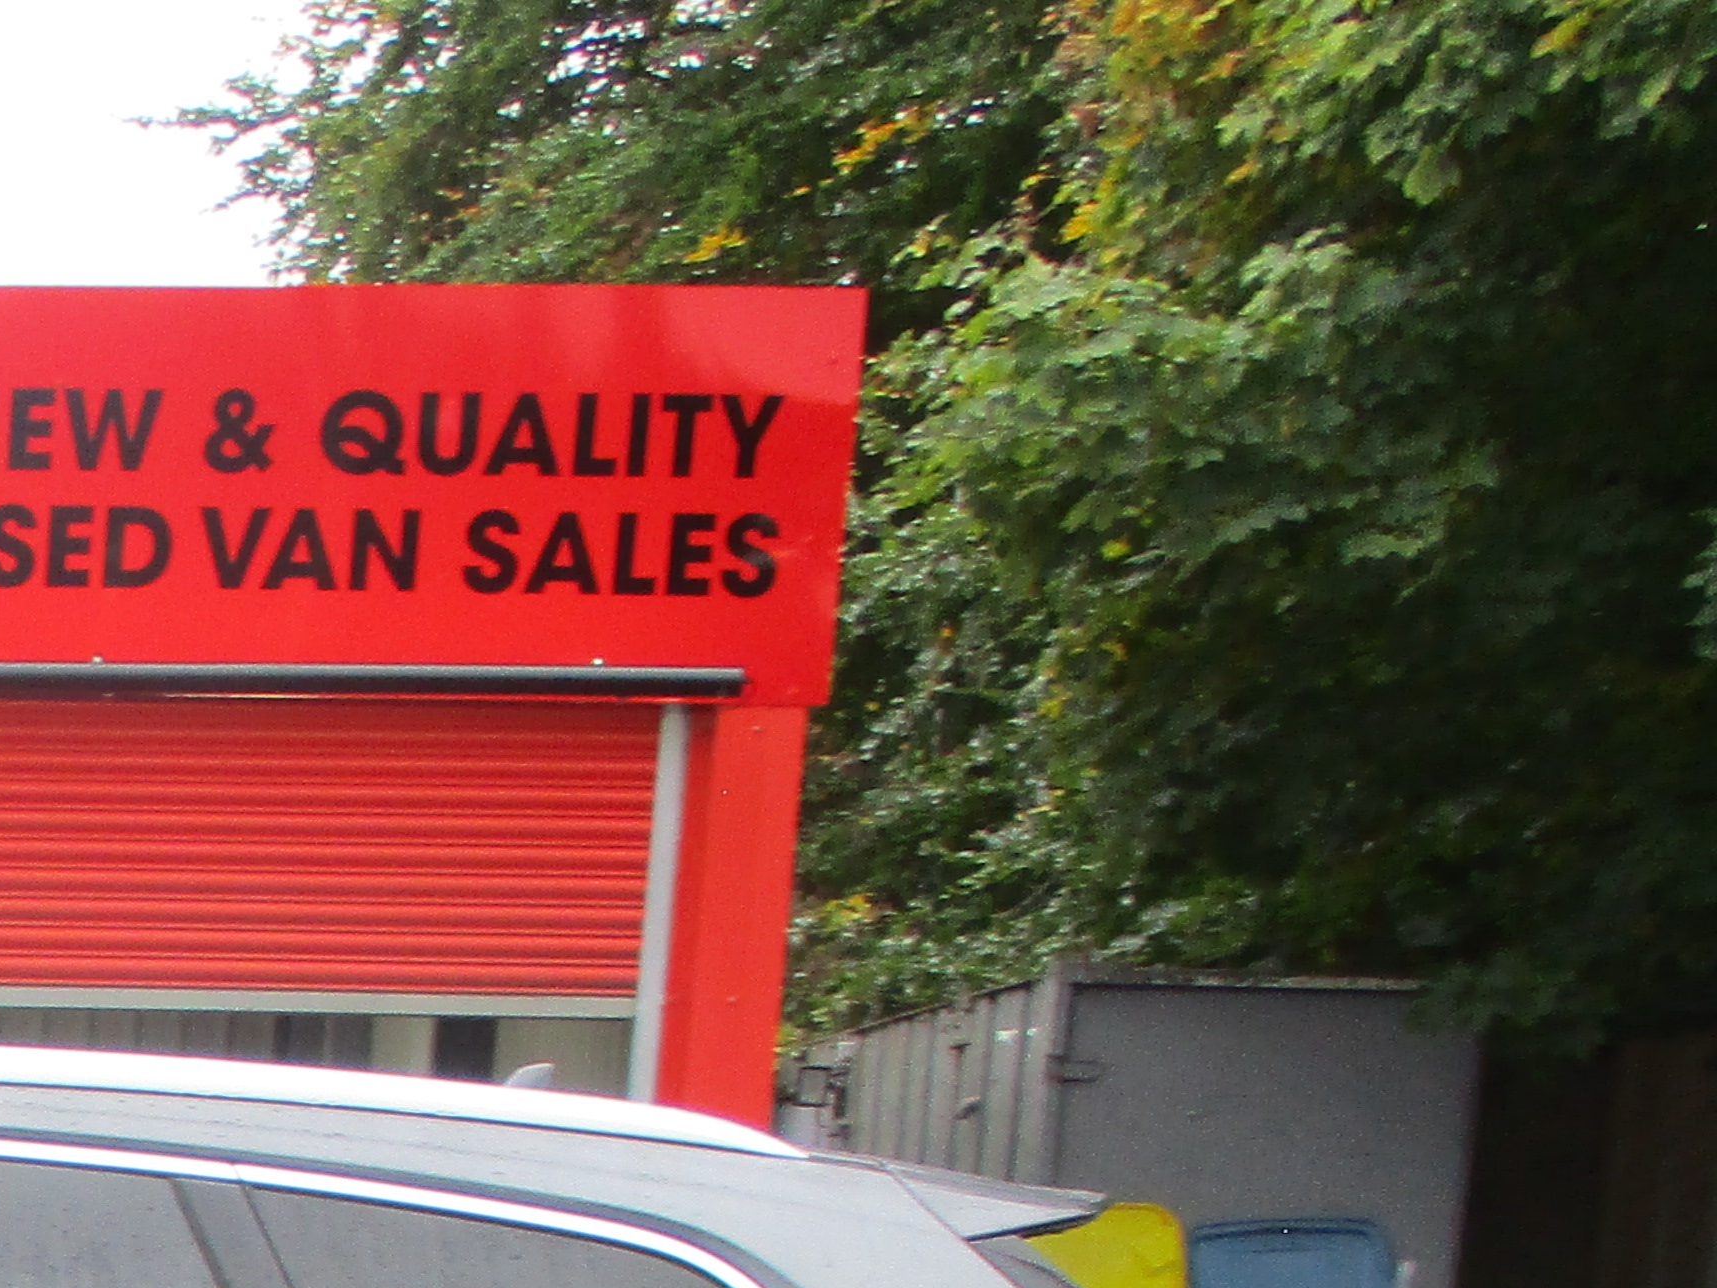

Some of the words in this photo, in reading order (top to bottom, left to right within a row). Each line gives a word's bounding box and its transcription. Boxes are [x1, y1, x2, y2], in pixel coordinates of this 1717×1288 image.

[204, 387, 275, 475] &
[320, 388, 786, 480] QUALITY
[201, 506, 422, 592] VAN
[462, 508, 781, 600] SALES
